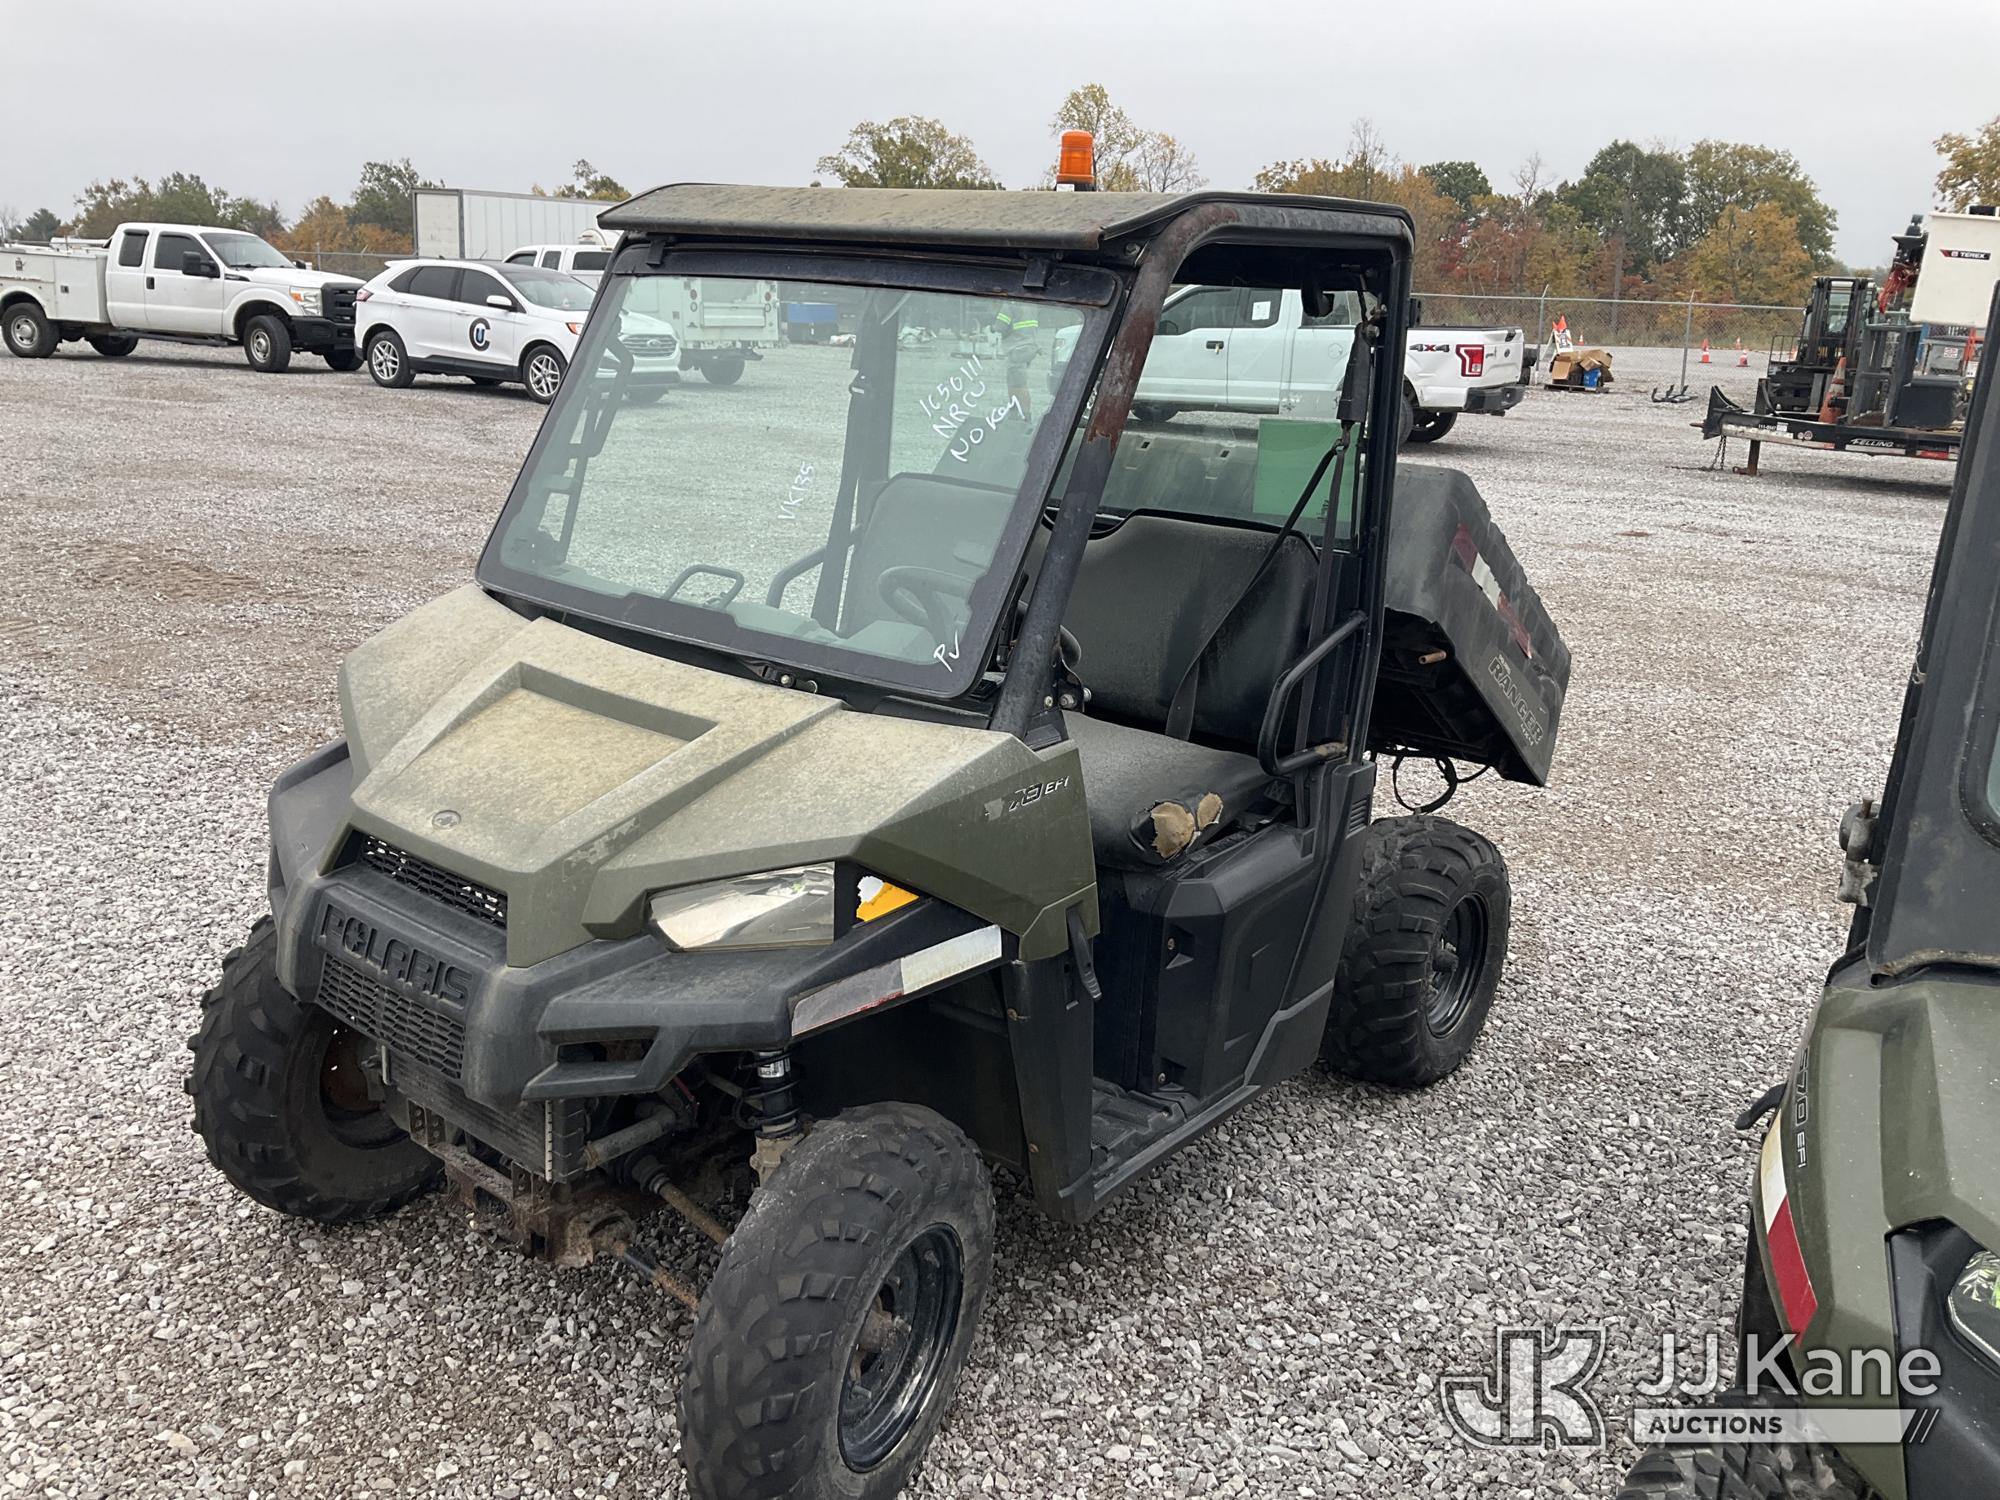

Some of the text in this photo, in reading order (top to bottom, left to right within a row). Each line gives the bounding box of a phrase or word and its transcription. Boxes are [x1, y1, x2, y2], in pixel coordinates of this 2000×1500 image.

[1488, 656, 1544, 745] RANGER
[1045, 776, 1070, 795] EFI
[320, 903, 474, 1011] POLARIS
